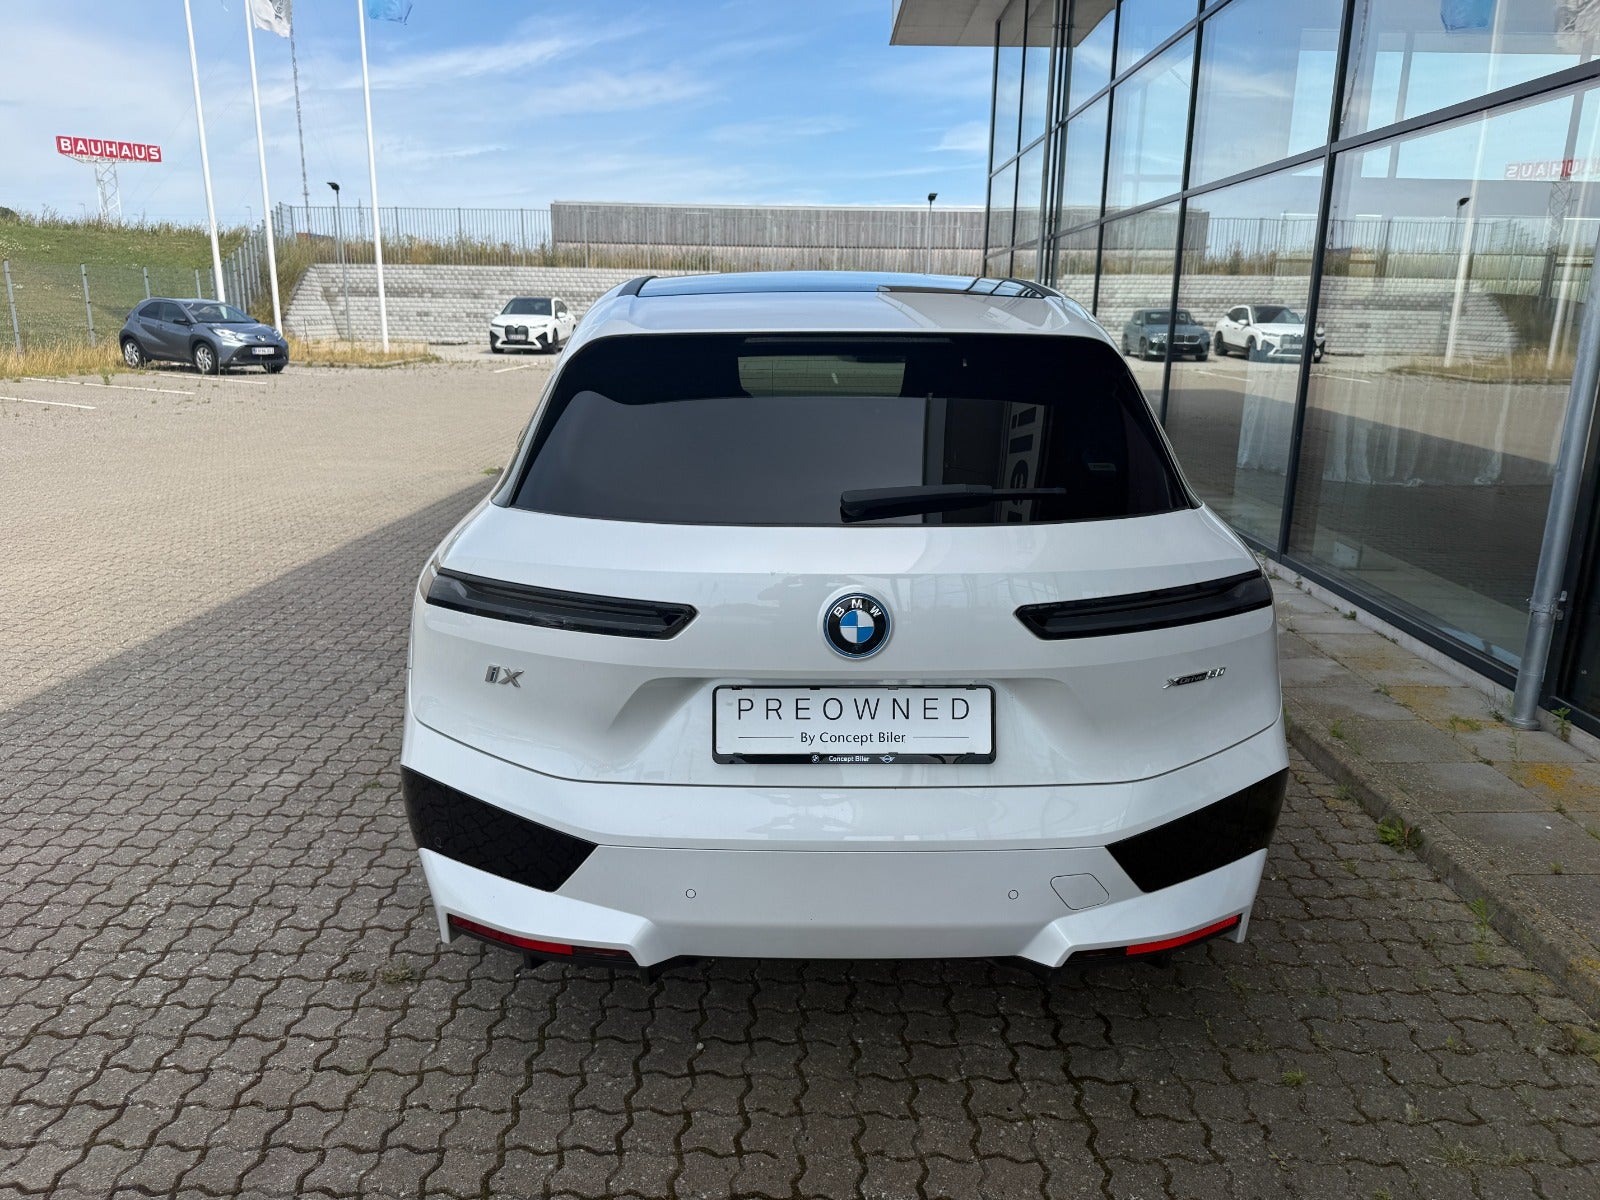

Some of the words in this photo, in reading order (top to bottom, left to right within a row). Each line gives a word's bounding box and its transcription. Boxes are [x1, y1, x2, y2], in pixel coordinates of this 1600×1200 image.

[59, 137, 161, 161] BAUHAUS
[833, 599, 882, 618] BMW
[737, 697, 970, 721] PREOWNED
[800, 731, 816, 746] By
[819, 731, 874, 747] Concept
[878, 731, 906, 743] Biler
[828, 755, 854, 763] Concept
